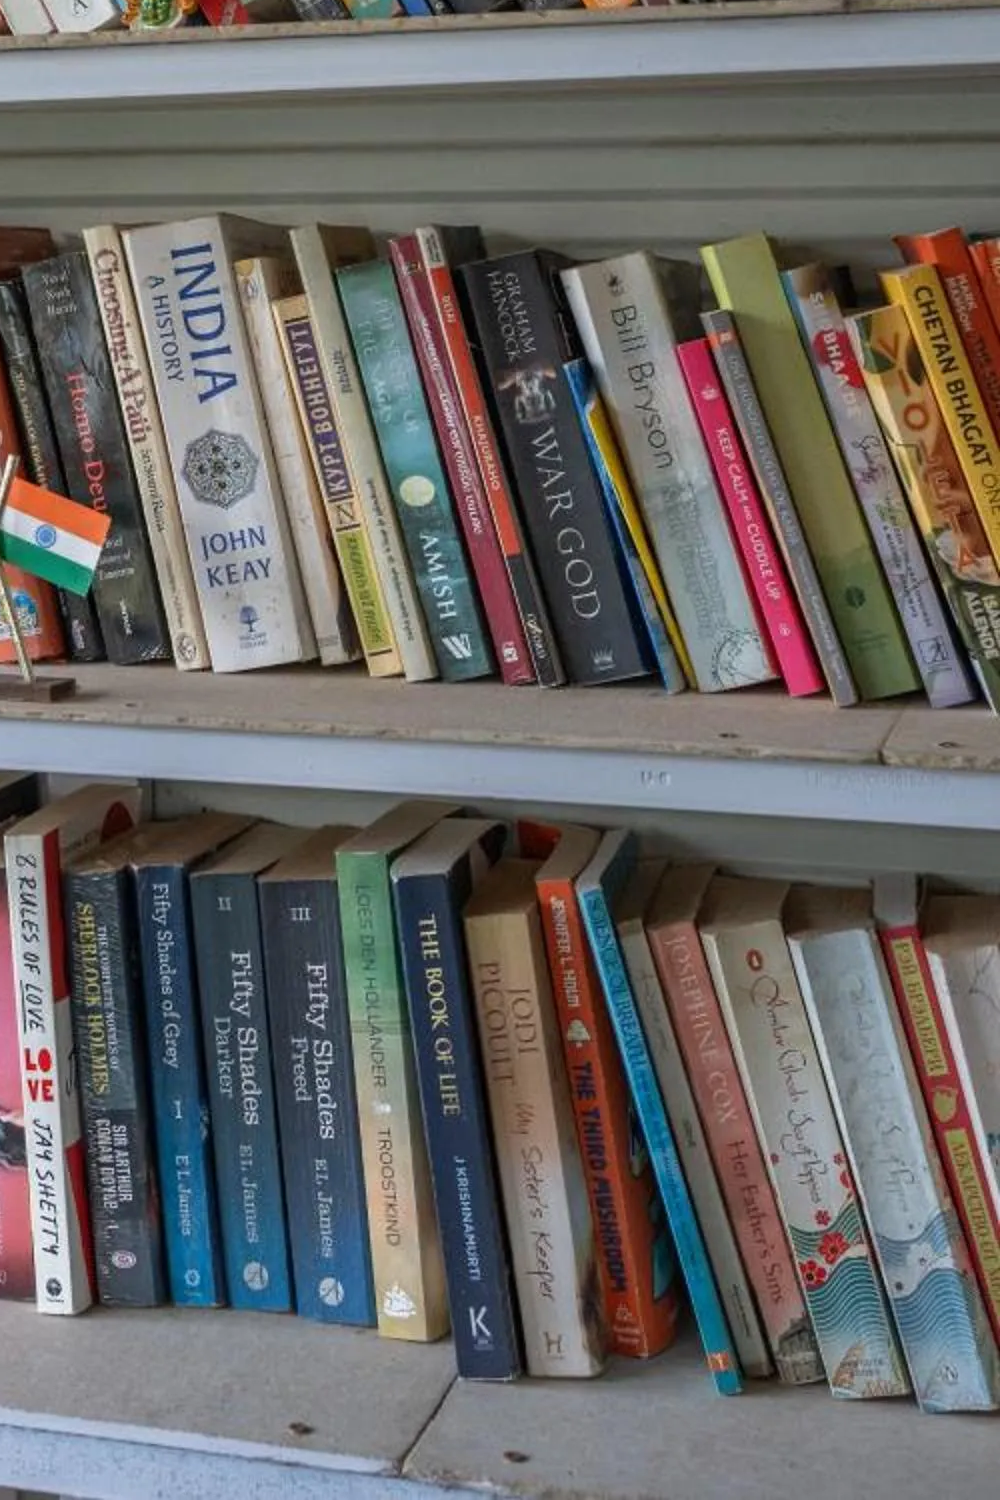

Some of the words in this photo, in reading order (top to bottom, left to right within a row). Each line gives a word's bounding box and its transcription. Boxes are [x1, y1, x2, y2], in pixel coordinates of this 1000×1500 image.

[96, 248, 132, 364] Choosing
[152, 292, 185, 383] HISTORY
[170, 242, 238, 406] INDIA
[488, 271, 526, 363] HANCOCK
[502, 272, 538, 353] GRAHAM
[610, 304, 650, 357] Bill
[65, 372, 95, 458] Homo
[626, 360, 674, 471] Bryson
[914, 284, 959, 375] CHETAN
[944, 374, 994, 469] BHAGAT
[473, 415, 501, 491] KHAJURAHO
[201, 525, 266, 556] JOHN
[530, 424, 574, 520] WAR
[557, 527, 602, 621] GOD
[746, 521, 774, 579] CUDDLE
[207, 558, 272, 588] KEAY
[420, 530, 457, 619] AMISH
[16, 872, 39, 944] RULES
[417, 913, 442, 959] THE
[20, 951, 42, 976] OF
[76, 901, 101, 1011] SHERLOCK
[230, 950, 252, 1017] Fifty
[306, 962, 329, 1030] Fifty
[424, 965, 448, 1031] BOOK
[22, 981, 47, 1035] LOVE
[366, 974, 389, 1090] HOLLANDER
[477, 961, 513, 1087] PICOULT
[512, 988, 538, 1056] JODI
[664, 935, 716, 1062] JOSEPHINE
[706, 1066, 739, 1122] COX
[86, 1010, 108, 1095] HOLMES
[212, 1016, 233, 1100] Darker
[236, 1027, 260, 1126] Shades
[290, 1037, 313, 1104] Freed
[313, 1038, 336, 1141] Shades
[439, 1073, 461, 1117] LIFE
[32, 1117, 57, 1160] JAY
[33, 1160, 61, 1258] SHETTY
[376, 1127, 403, 1248] TROOSTKIND
[453, 1169, 482, 1283] KRISHNAMURTI
[529, 1229, 556, 1302] Keeper
[590, 1172, 631, 1293] MUSHROOM
